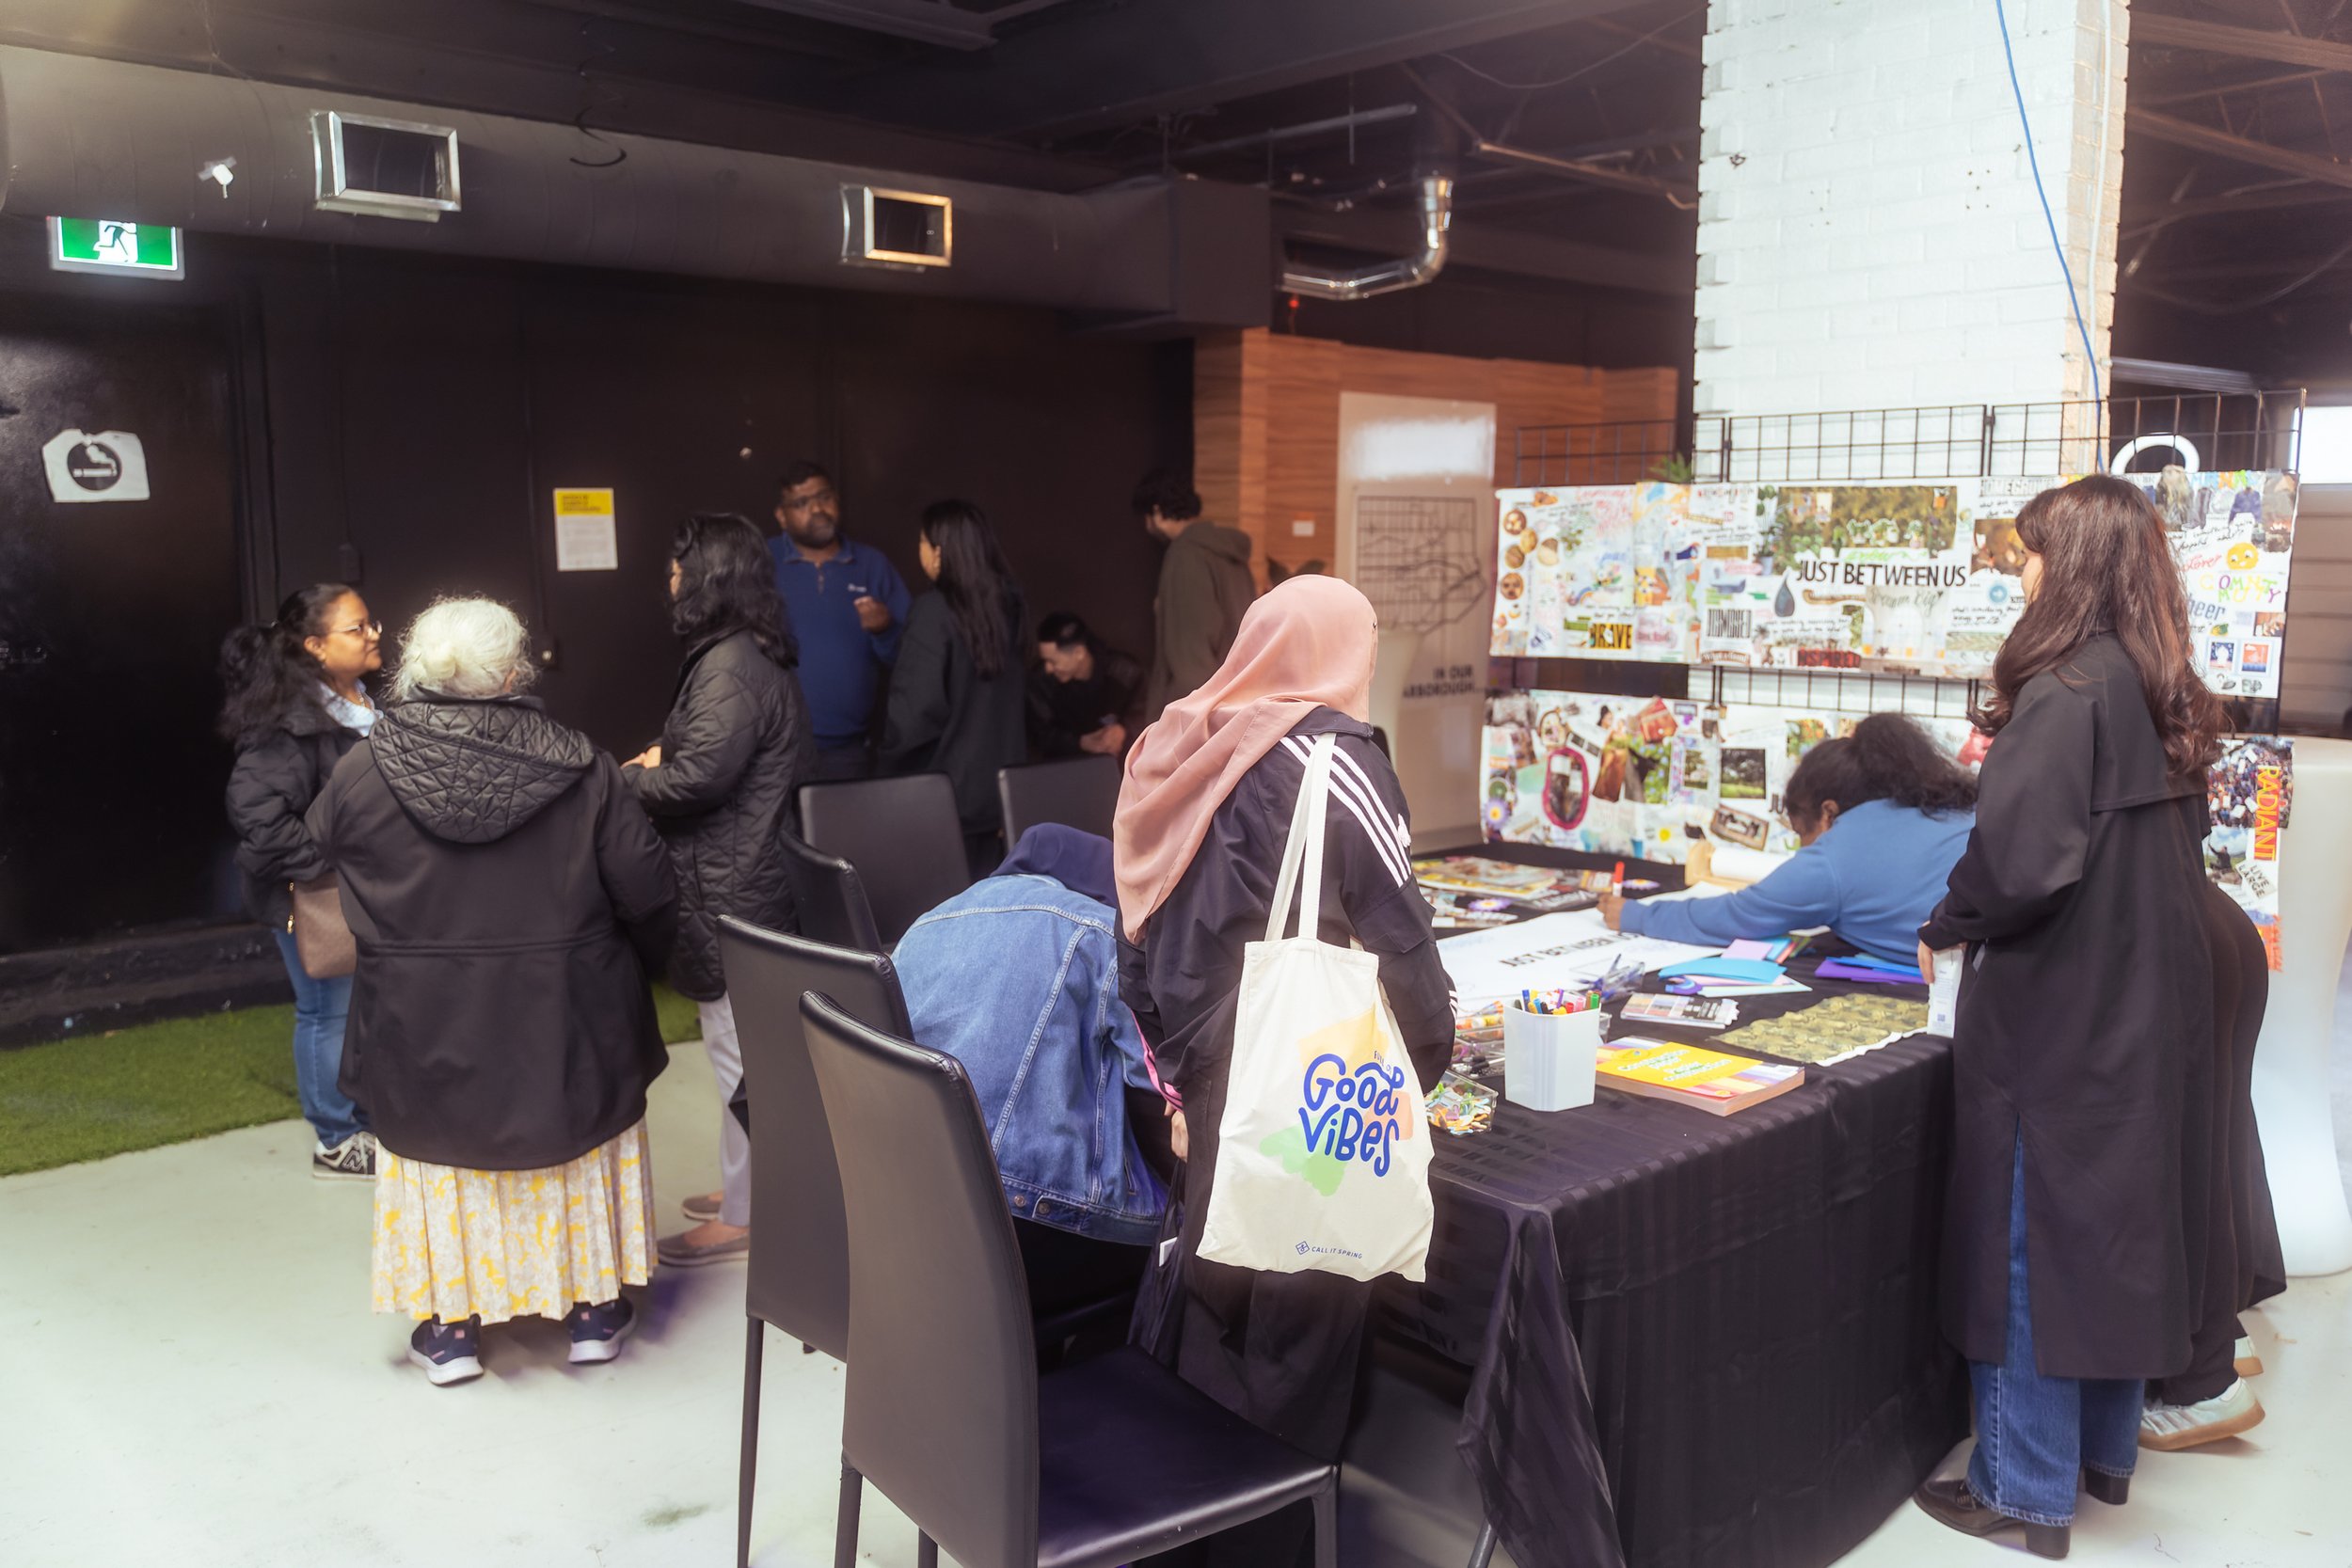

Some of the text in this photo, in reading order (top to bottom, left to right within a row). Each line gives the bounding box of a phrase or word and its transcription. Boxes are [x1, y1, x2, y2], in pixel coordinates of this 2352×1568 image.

[1796, 561, 1966, 587] JUST BETWEEN US
[2253, 766, 2280, 862] RADIANT
[1338, 1249, 1362, 1259] SPRING
